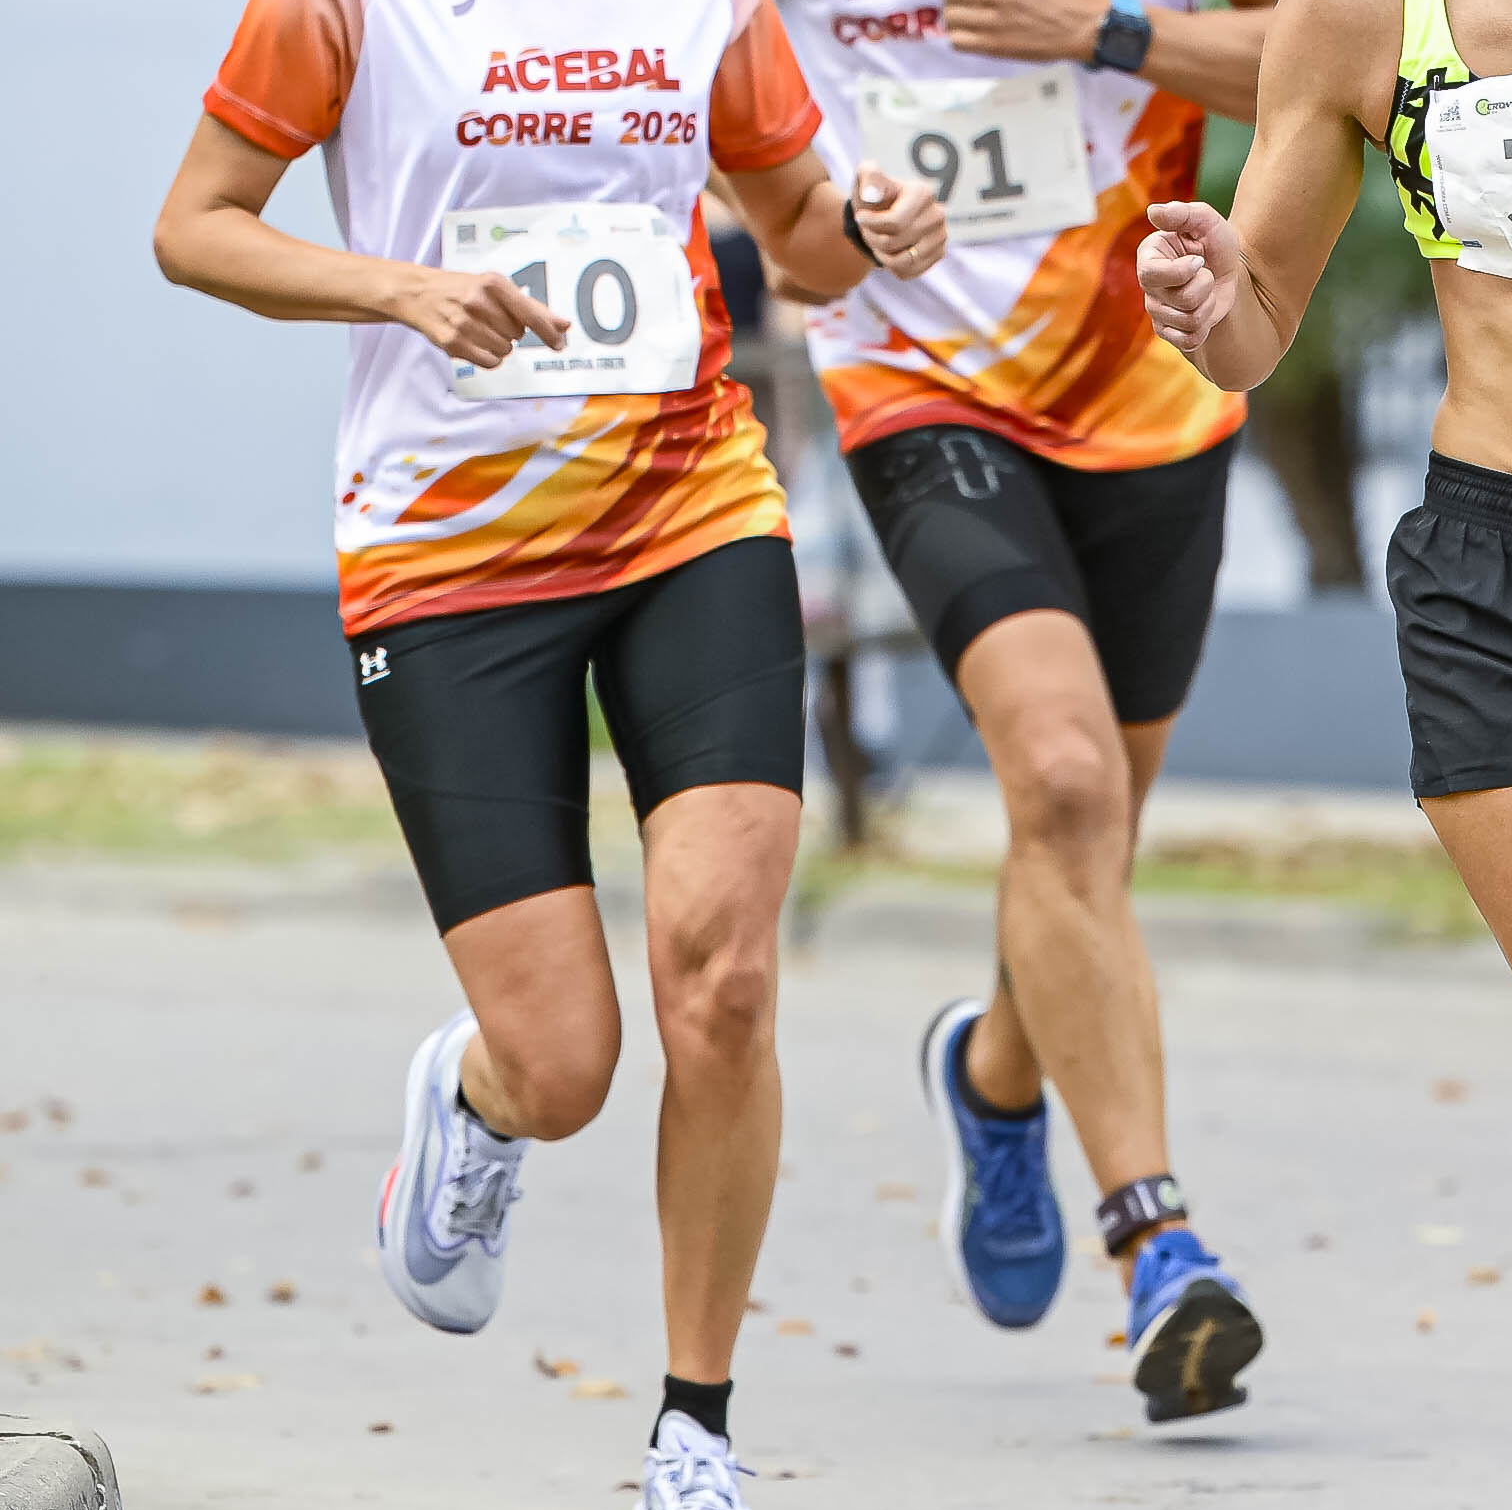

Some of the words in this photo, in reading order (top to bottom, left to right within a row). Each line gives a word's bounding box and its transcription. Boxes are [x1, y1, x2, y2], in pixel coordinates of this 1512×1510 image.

[832, 6, 947, 48] CORR
[482, 47, 680, 93] ACEBAL
[456, 111, 592, 148] CORRE
[619, 111, 696, 146] 2026
[910, 127, 1027, 203] 91
[511, 259, 638, 348] 10
